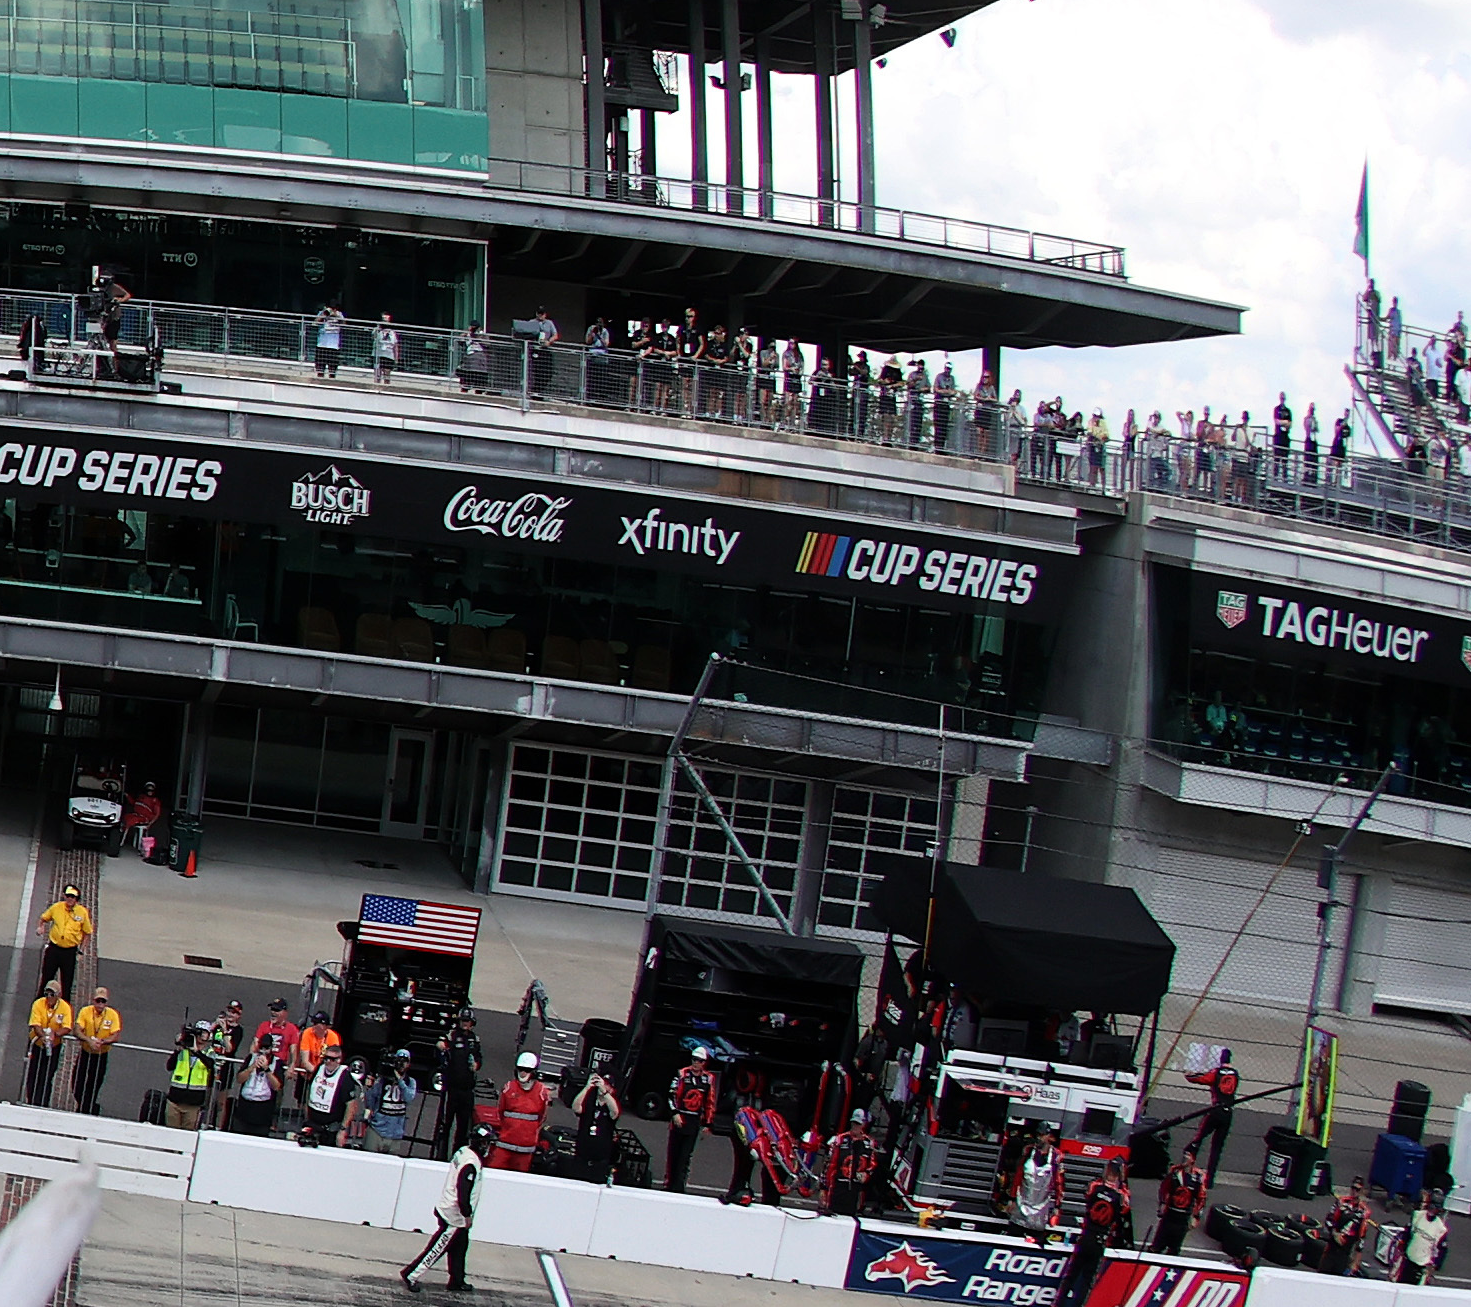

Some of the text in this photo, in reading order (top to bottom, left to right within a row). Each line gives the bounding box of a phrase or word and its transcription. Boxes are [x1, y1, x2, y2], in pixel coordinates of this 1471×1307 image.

[77, 449, 222, 502] SERIES
[290, 483, 372, 516] BUSCH
[444, 485, 573, 543] Coca-Cola
[305, 510, 352, 524] LIGHT
[618, 508, 740, 565] xfinity
[847, 539, 1037, 605] CUP SERIES
[1219, 594, 1246, 607] TAG
[384, 1084, 401, 1103] 20
[1034, 1088, 1060, 1100] Haas
[985, 1249, 1068, 1279] Road
[962, 1275, 1073, 1305] Range
